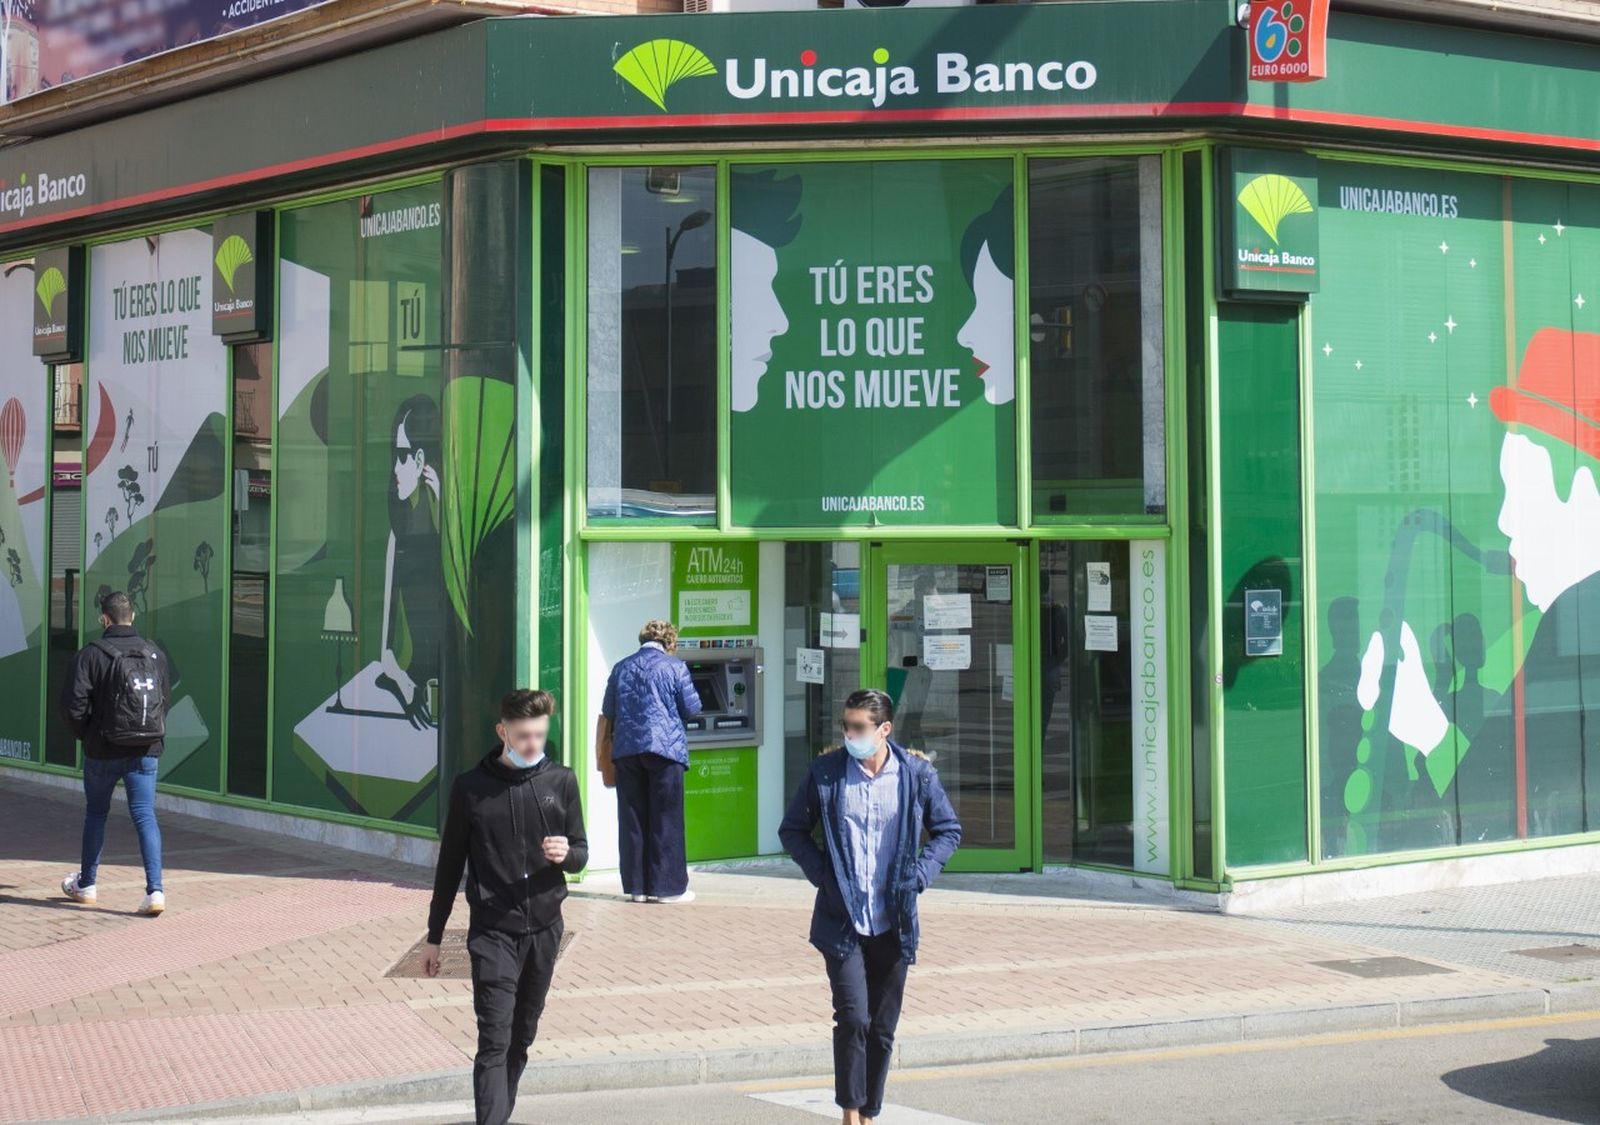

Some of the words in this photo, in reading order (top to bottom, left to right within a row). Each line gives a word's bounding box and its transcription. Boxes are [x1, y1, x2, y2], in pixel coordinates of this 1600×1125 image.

[228, 0, 284, 18] ACCIDEN
[725, 48, 919, 108] Unicaja
[936, 52, 1098, 95] Banco
[1251, 64, 1279, 77] EURO
[1280, 62, 1308, 75] 6000
[38, 173, 86, 204] Banco
[1340, 186, 1458, 219] UNICAJABANCO.ES
[361, 202, 441, 238] UNICAJABANCO.ES
[1238, 247, 1280, 267] Unicaja
[1282, 252, 1315, 266] Banco
[113, 280, 127, 320] TÚ
[130, 282, 158, 318] ERES
[161, 280, 175, 314] LO
[178, 276, 201, 313] QUE
[809, 259, 848, 305] TÚ
[857, 264, 934, 304] ERES
[400, 288, 421, 340] TÚ
[123, 330, 145, 365] NOS
[148, 324, 189, 362] MUEVE
[820, 318, 856, 357] LO
[865, 317, 925, 358] QUE
[785, 370, 846, 409] NOS
[855, 369, 961, 408] MUEVE
[147, 441, 159, 473] TÚ
[822, 495, 925, 512] UNICAJABANCO.ES
[687, 547, 723, 573] ATM
[723, 558, 743, 573] 24h
[1140, 549, 1160, 863] www.unicajabanco.es
